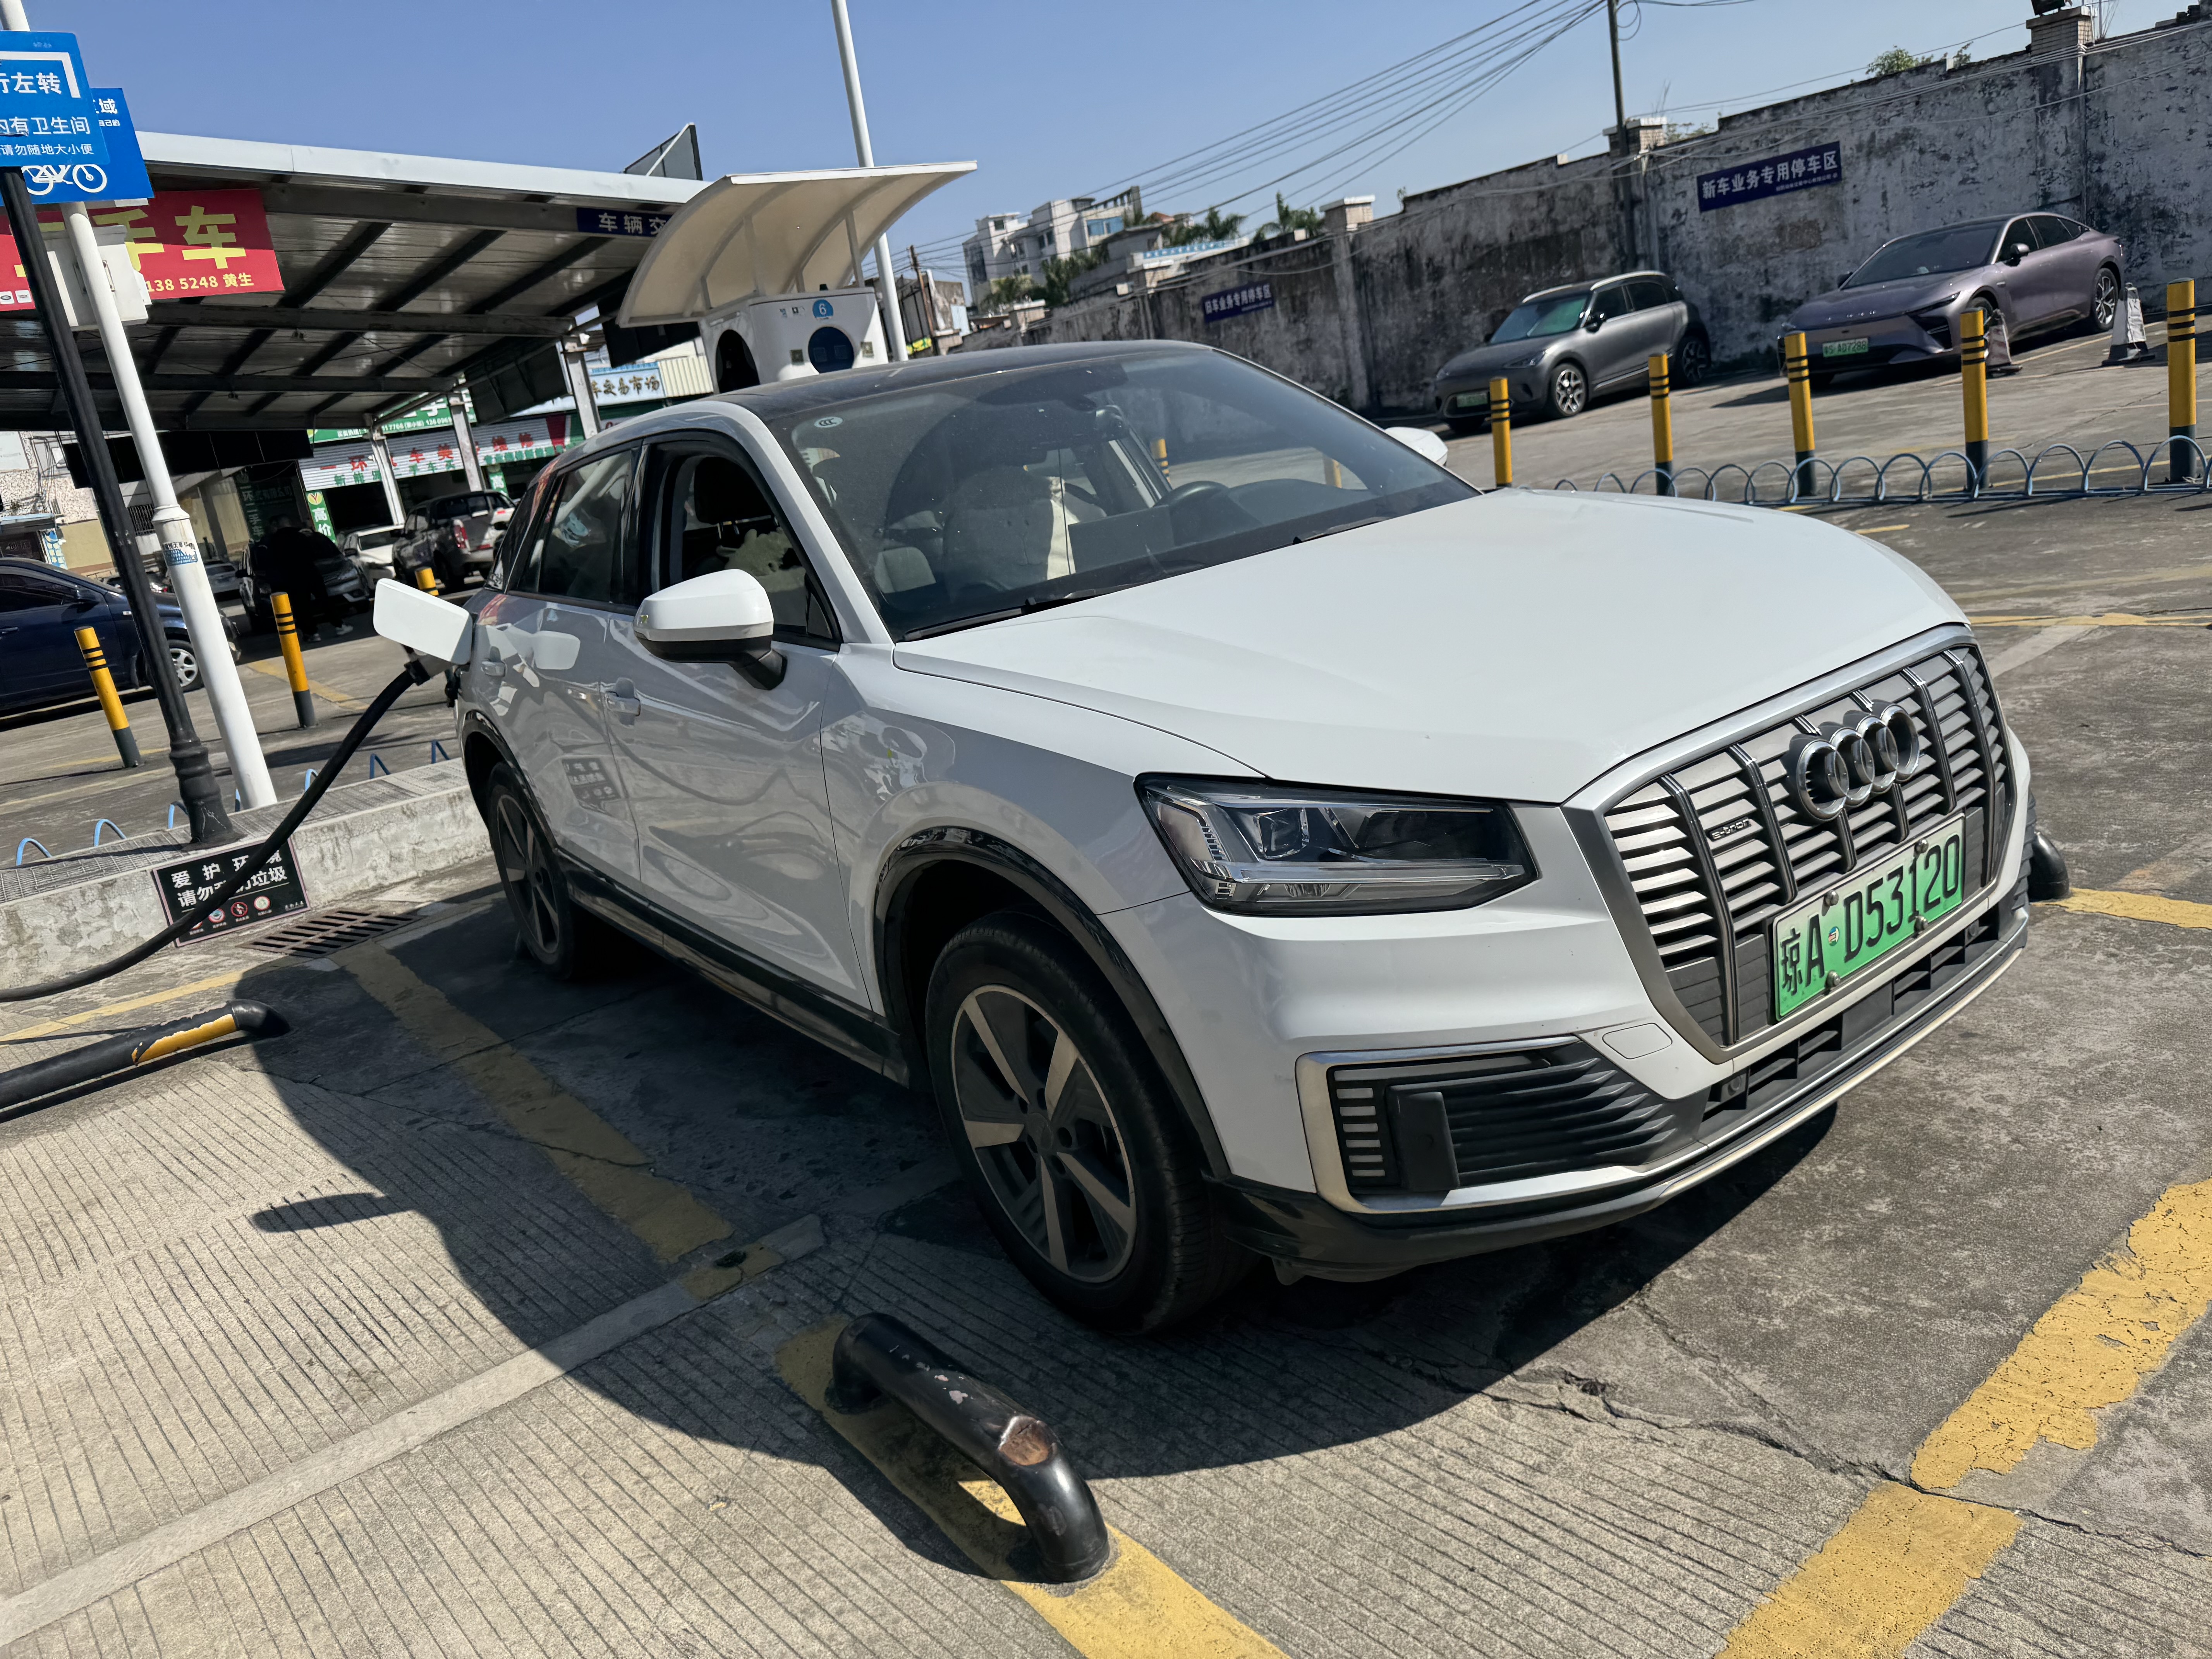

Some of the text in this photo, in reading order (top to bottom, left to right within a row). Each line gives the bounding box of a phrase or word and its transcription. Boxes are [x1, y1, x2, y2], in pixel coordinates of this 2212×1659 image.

[0, 143, 94, 155] 请勿随地大小便
[1702, 151, 1837, 199] 新车业务专用停车区
[179, 276, 218, 290] 5248
[223, 272, 254, 287] 黄生
[819, 304, 826, 315] 6
[178, 866, 287, 907] 请勿垃圾
